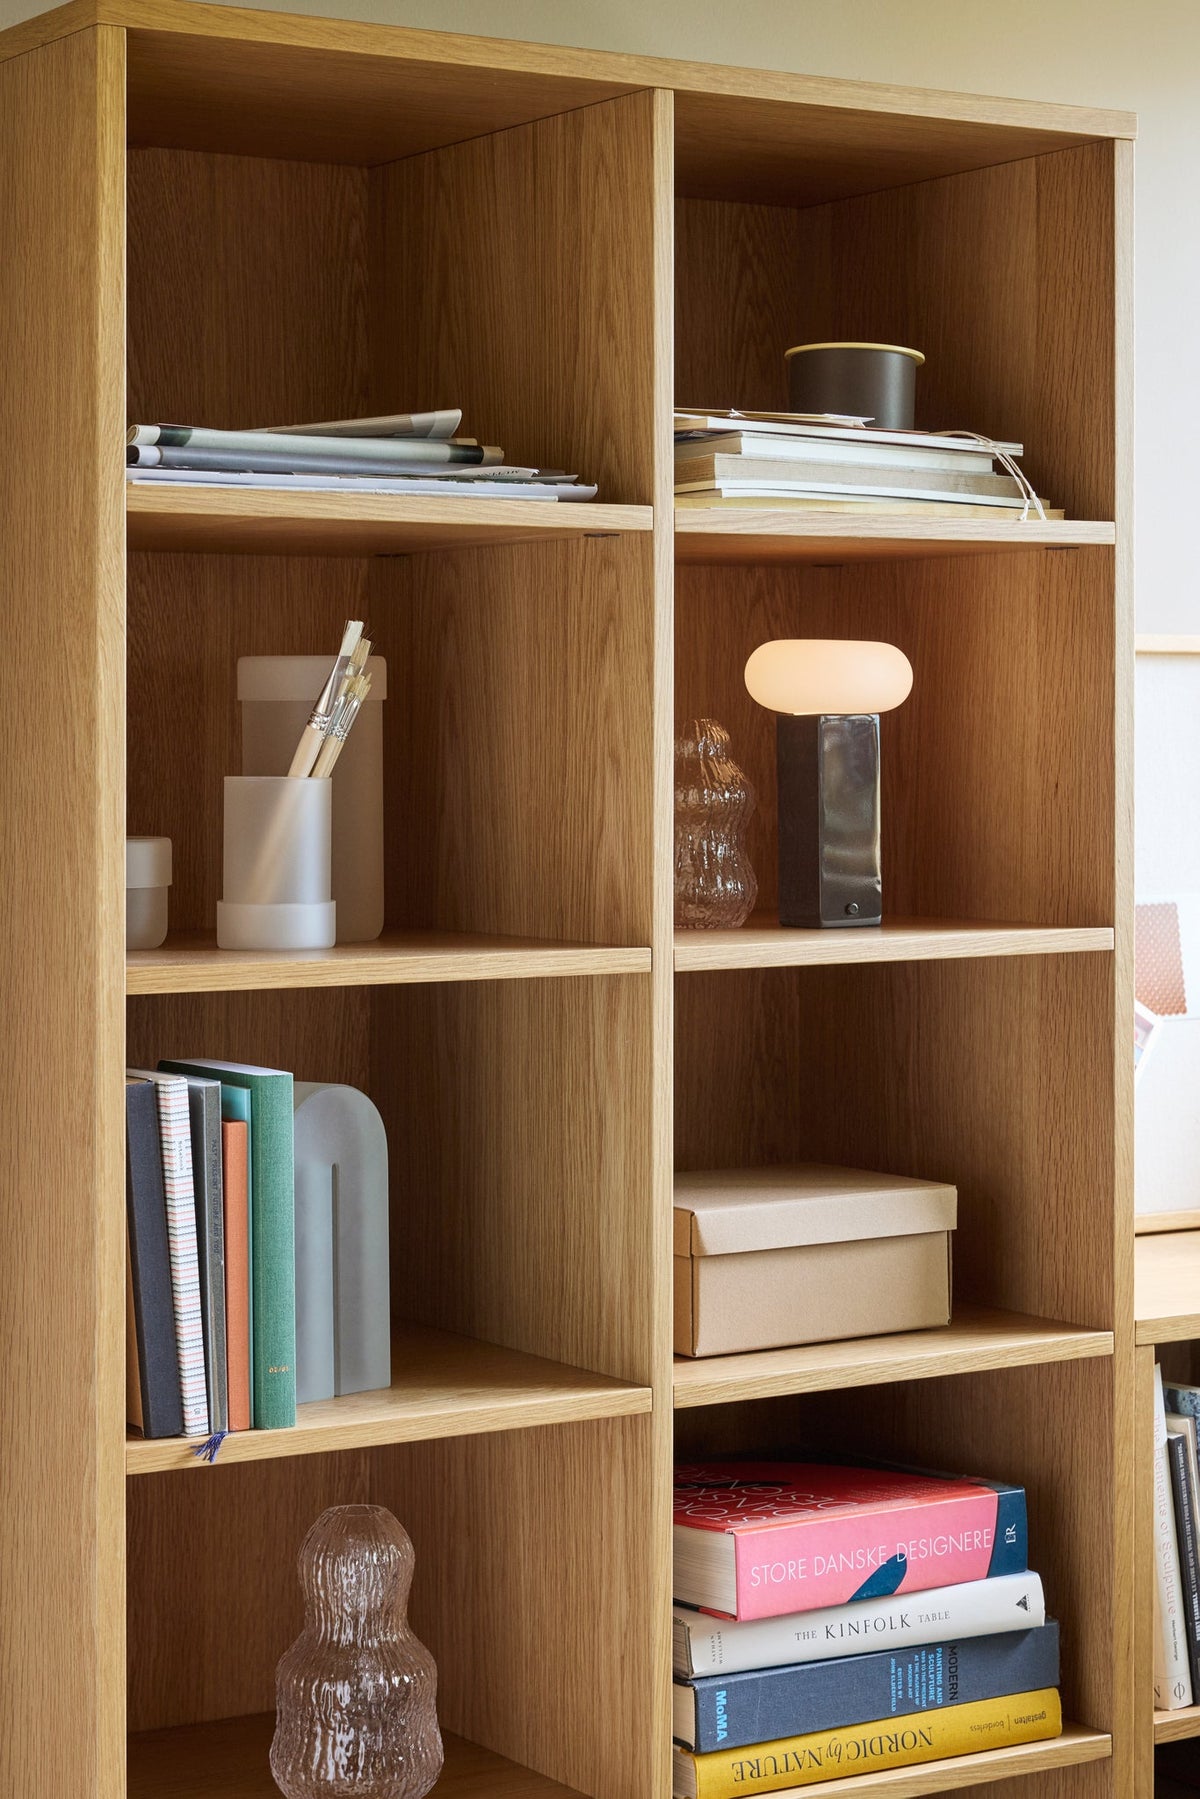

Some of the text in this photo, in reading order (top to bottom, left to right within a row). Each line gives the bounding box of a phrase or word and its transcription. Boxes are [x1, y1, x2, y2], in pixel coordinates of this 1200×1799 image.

[750, 1528, 992, 1587] STORE DANSKE DESIGNERE
[1160, 1540, 1176, 1616] Sculpture
[794, 1611, 951, 1641] THE KINFOLK TABLE
[935, 1647, 943, 1686] PAINTING
[948, 1645, 959, 1701] MODERN
[715, 1690, 728, 1742] MoMA
[969, 1710, 1047, 1733] gestalten borderless
[731, 1726, 933, 1782] NORDIC by NATURE
